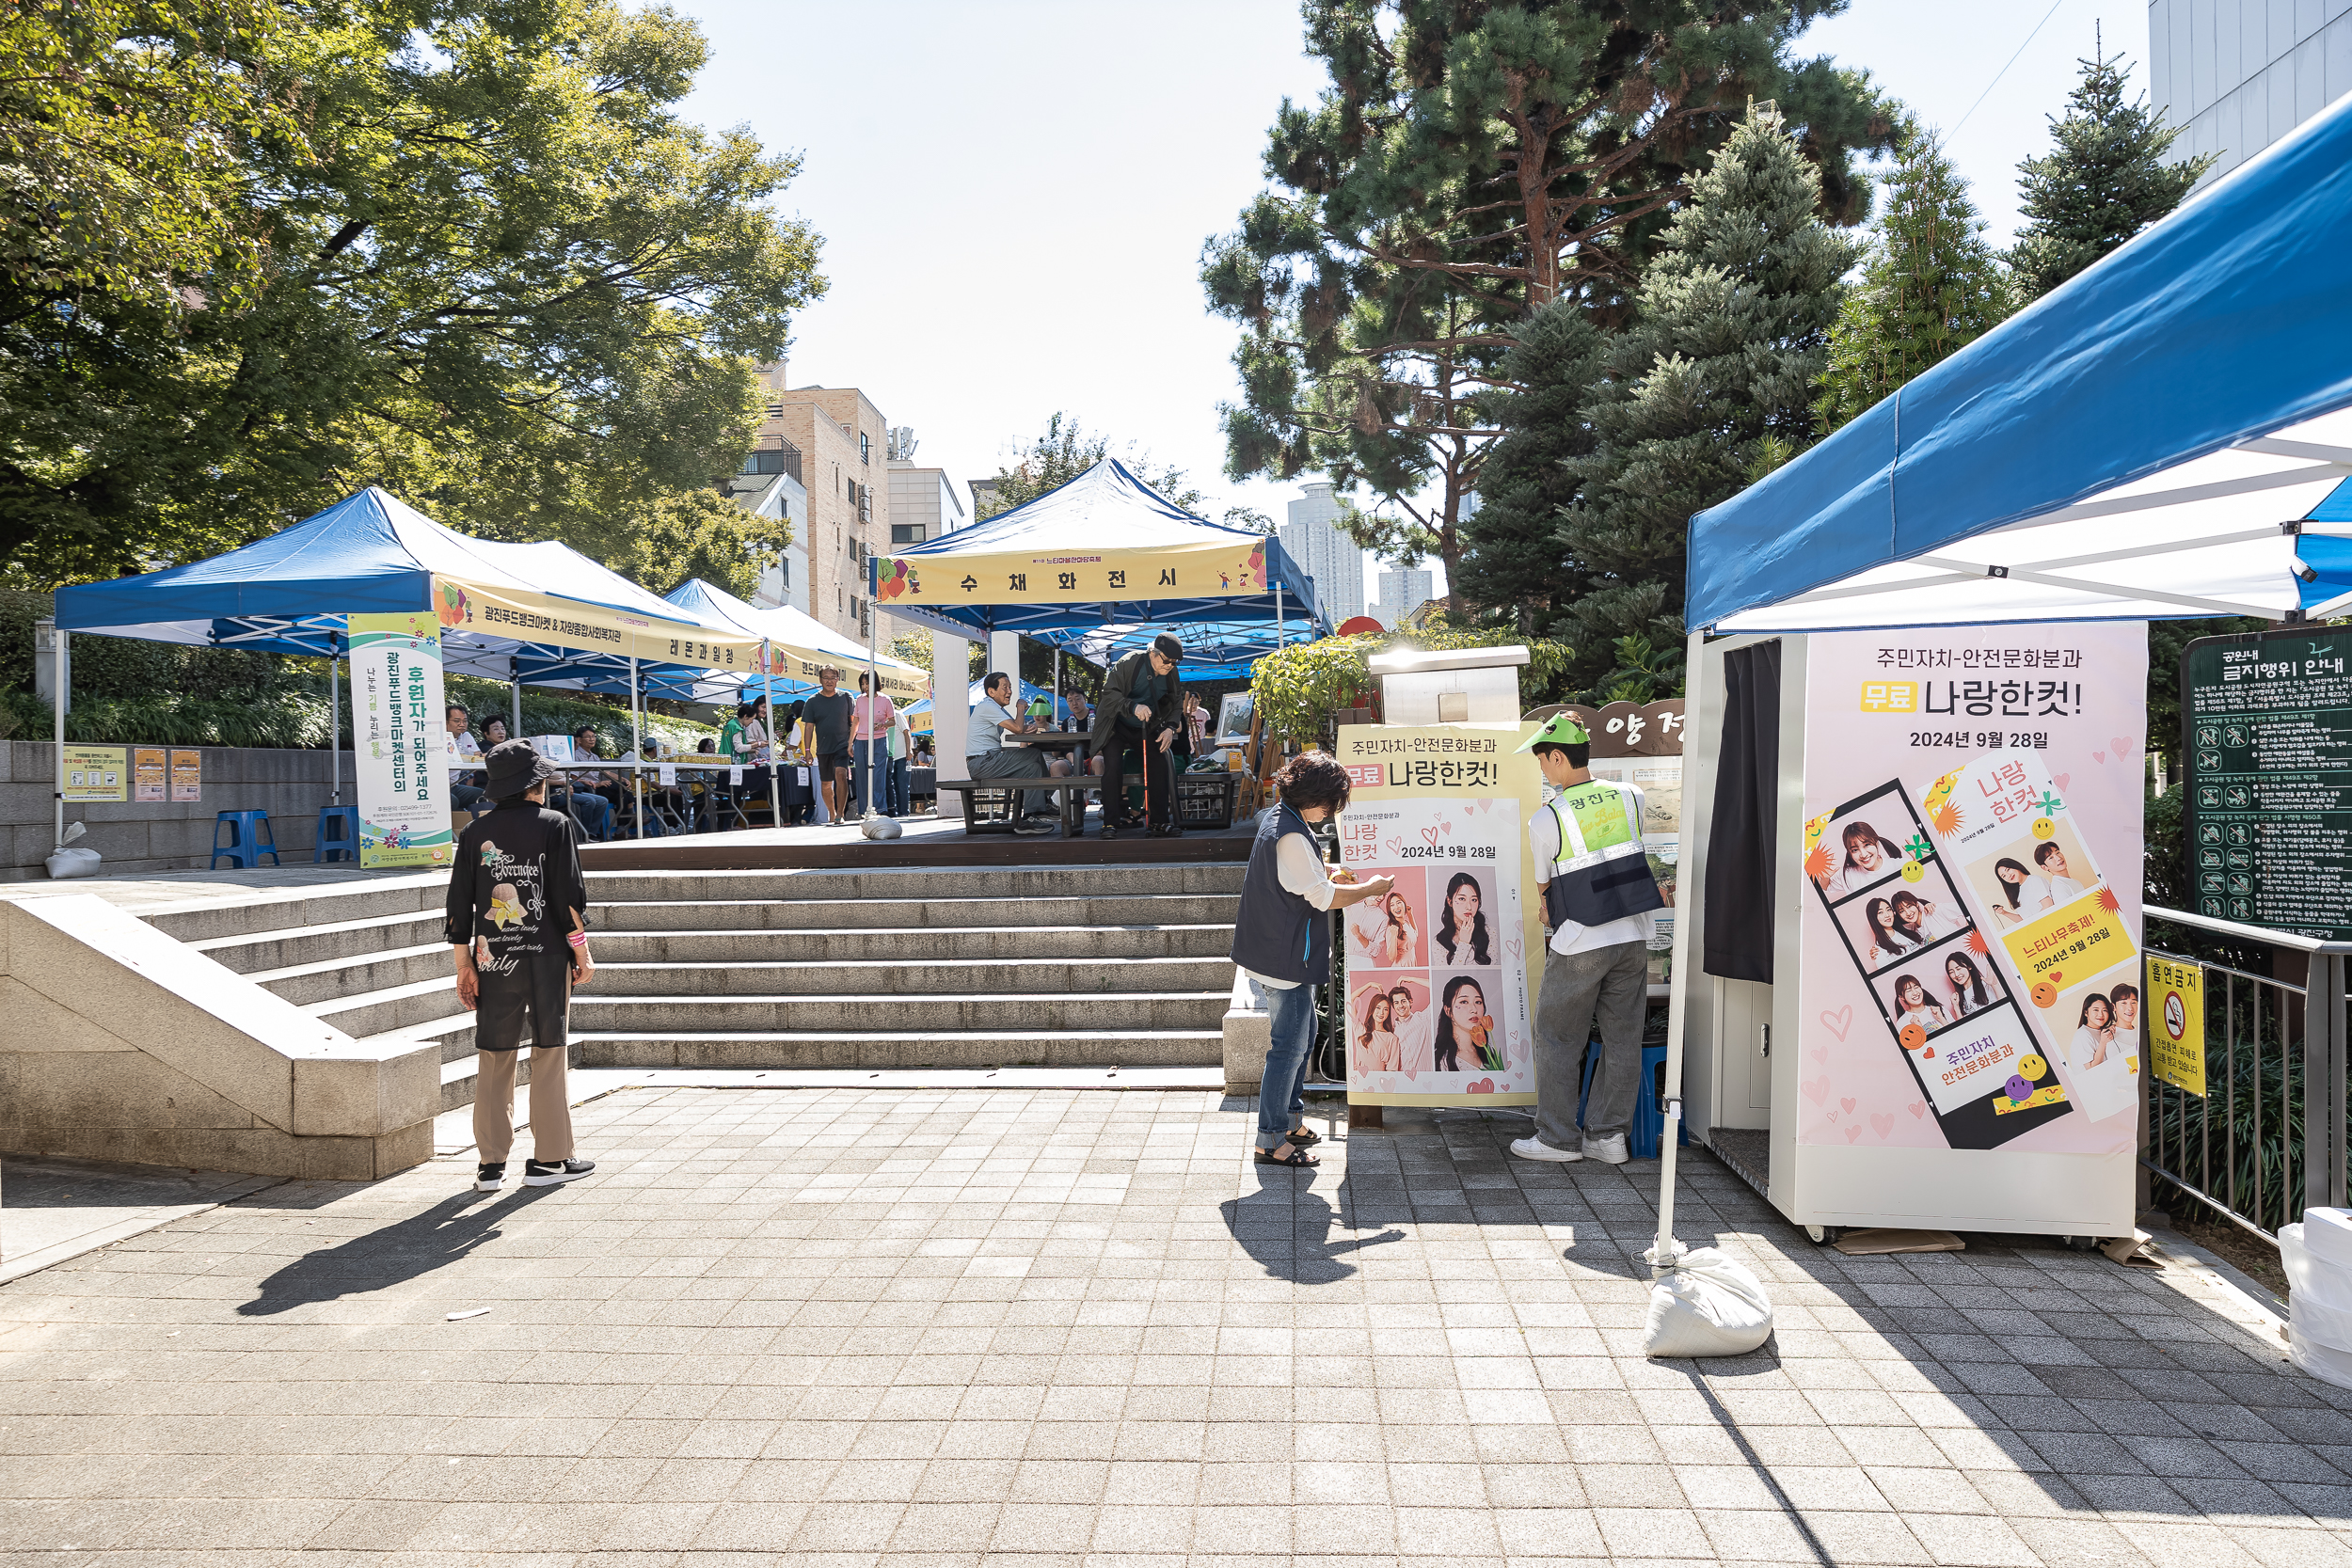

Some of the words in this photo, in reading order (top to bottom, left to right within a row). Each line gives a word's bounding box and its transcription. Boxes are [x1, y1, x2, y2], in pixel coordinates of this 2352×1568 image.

[1046, 556, 1102, 564] 느티마을한마당축제
[485, 606, 552, 631] 광진푸드뱅크마켓
[552, 620, 559, 632] &
[559, 619, 622, 643] 자양종합사회복지관
[1877, 648, 2082, 669] 주민자치-안전문화분과
[2222, 649, 2260, 663] 공원내
[367, 668, 377, 692] 나누는
[2223, 661, 2296, 681] 금지행위
[2305, 657, 2344, 675] 안내
[407, 666, 426, 732] 후원자가
[1865, 684, 1911, 710] 무료
[1925, 680, 2081, 717] 나랑한컷!
[387, 652, 405, 792] 광진푸드뱅크마켓센터의
[1351, 737, 1498, 756] 주민자치-안전문화분과
[1910, 731, 1970, 749] 2024년
[1976, 731, 2004, 748] 9월
[2010, 731, 2049, 749] 28일
[413, 737, 429, 800] 되어주세요
[1349, 767, 1380, 785] 무료
[1389, 761, 1498, 787] 나랑한컷!
[1977, 759, 2024, 800] 나랑
[1569, 789, 1619, 810] 광진구
[1989, 784, 2042, 825] 한컷
[1343, 812, 1400, 821] 주민자치-안전문화분과
[1343, 824, 1378, 841] 나랑
[1343, 844, 1378, 862] 한컷
[1401, 846, 1445, 859] 2024년
[1449, 846, 1467, 858] 9월
[1470, 846, 1496, 859] 28일
[2023, 913, 2096, 958] 느티나무축제!
[2033, 948, 2070, 974] 2024년
[2069, 939, 2086, 956] 9월
[2088, 927, 2111, 947] 28일
[2153, 962, 2197, 992] 흡연금지
[1946, 1035, 1996, 1067] 주민자치
[2155, 1037, 2177, 1054] 간접흡연
[2179, 1046, 2197, 1061] 피해로
[1941, 1043, 2014, 1086] 안전문화분과
[2156, 1052, 2167, 1065] 고통
[2167, 1055, 2177, 1069] 받고
[2178, 1059, 2199, 1077] 있습니다
